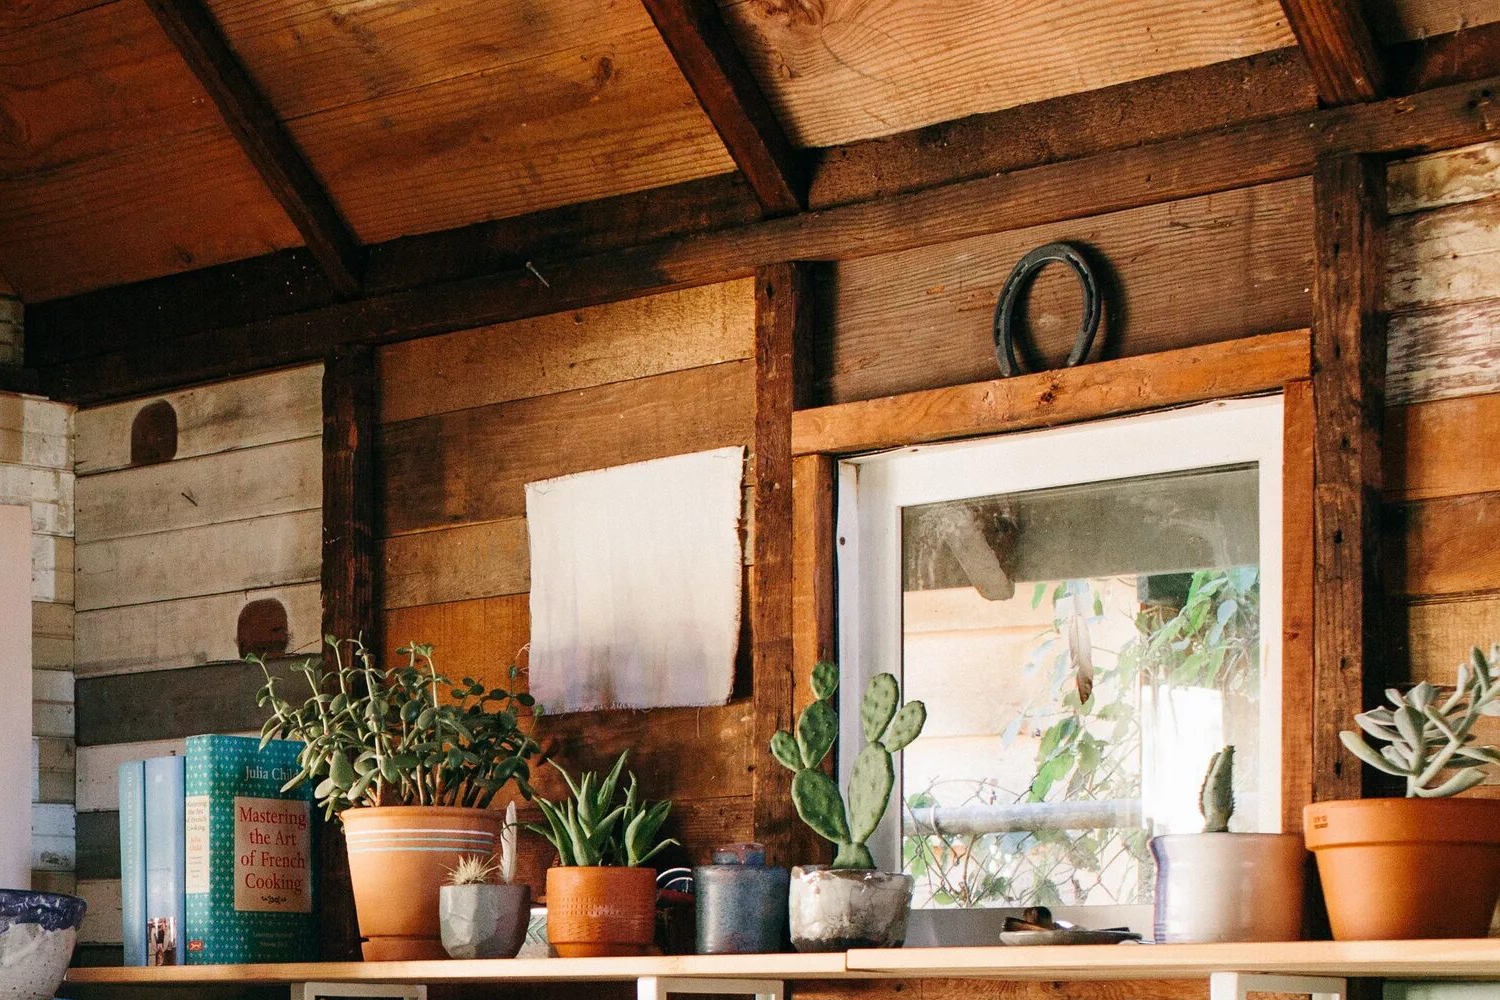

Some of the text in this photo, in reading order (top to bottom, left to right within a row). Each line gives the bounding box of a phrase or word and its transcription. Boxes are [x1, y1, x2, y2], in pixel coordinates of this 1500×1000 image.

[244, 766, 269, 782] Julia
[239, 806, 307, 830] Mastering
[249, 828, 297, 846] the Art
[240, 850, 305, 869] of French
[245, 873, 302, 895] Cooking
